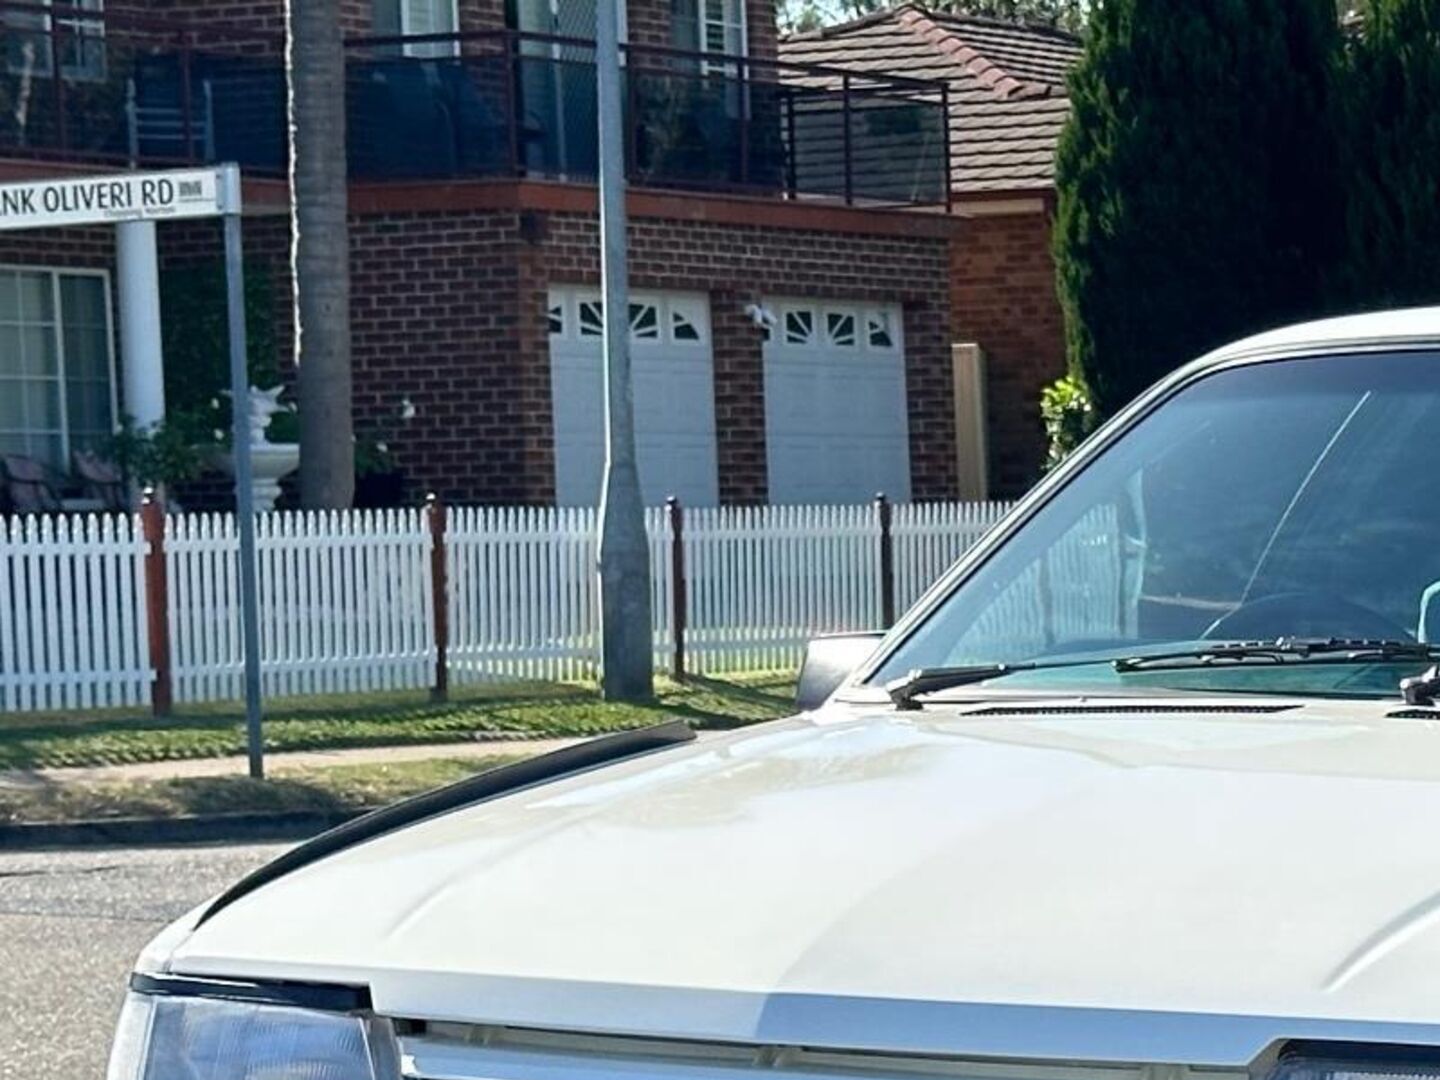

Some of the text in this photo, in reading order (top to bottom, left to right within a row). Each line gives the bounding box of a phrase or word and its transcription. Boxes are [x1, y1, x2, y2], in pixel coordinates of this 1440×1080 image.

[0, 188, 36, 216] NK
[43, 183, 132, 212] OLIVERI
[142, 179, 174, 206] RD
